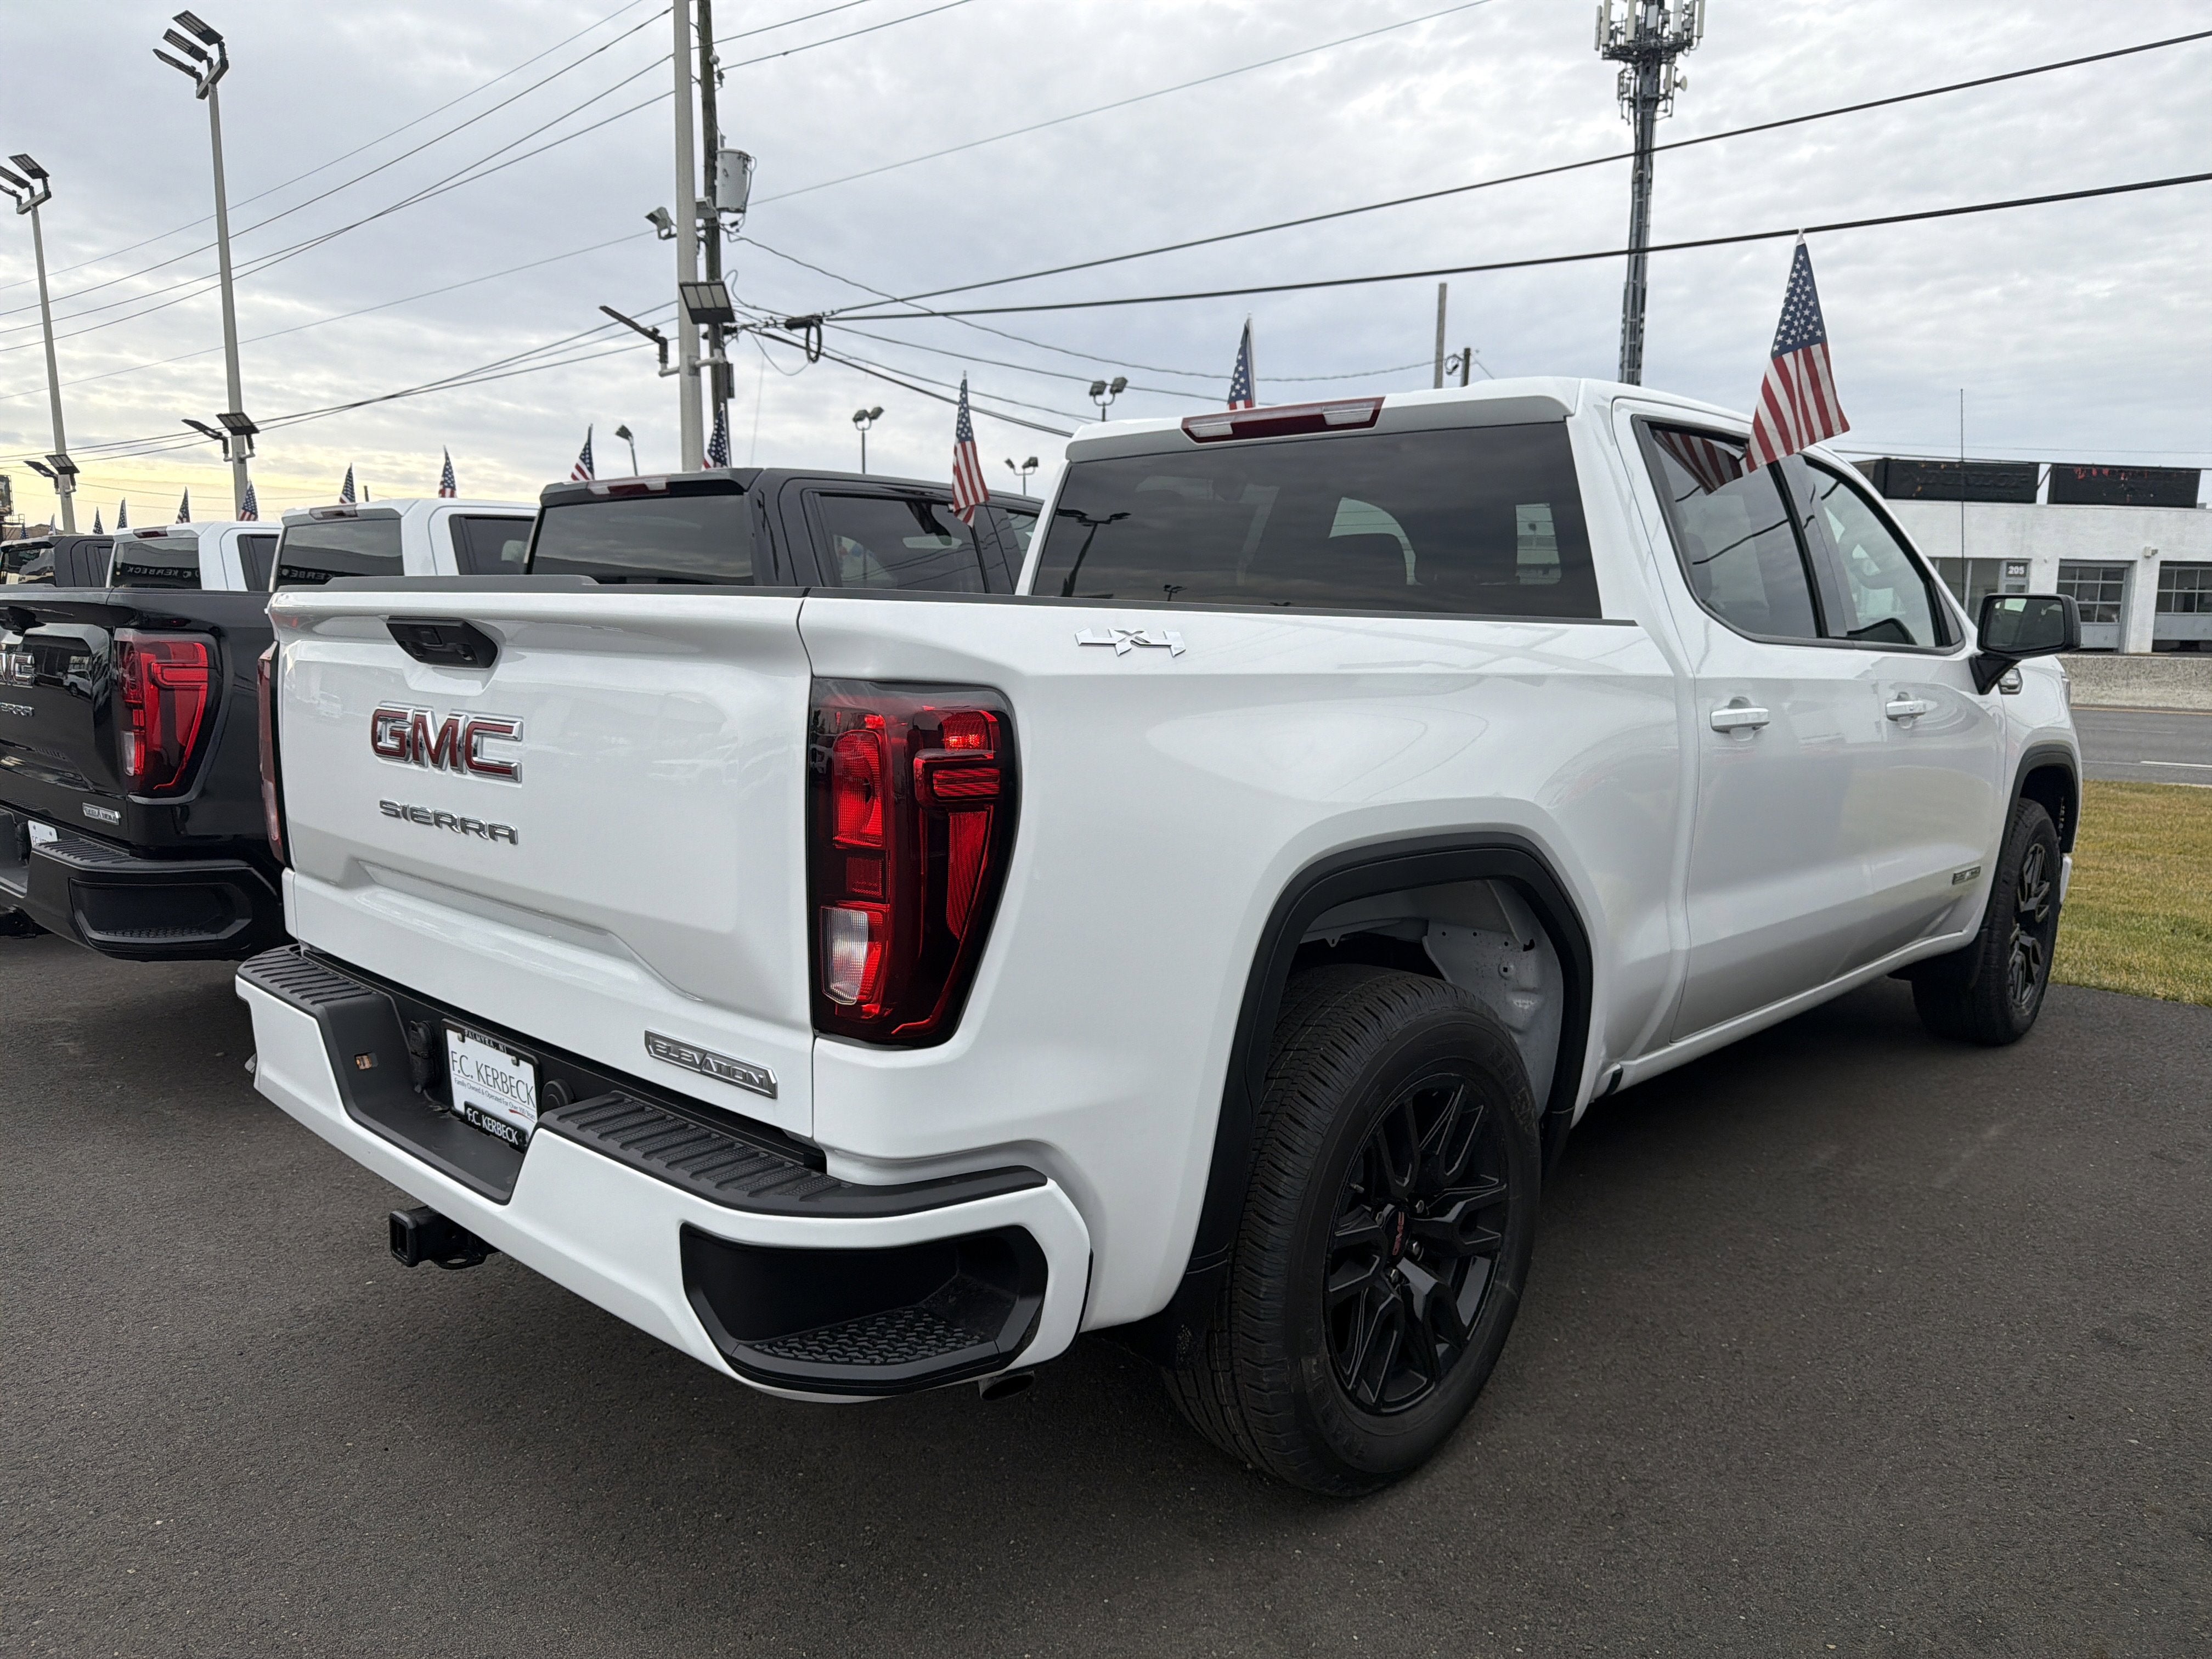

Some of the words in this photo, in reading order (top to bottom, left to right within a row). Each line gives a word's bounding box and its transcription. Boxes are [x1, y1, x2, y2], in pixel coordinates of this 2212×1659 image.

[2008, 565, 2024, 575] 205
[0, 652, 35, 686] MC
[0, 702, 35, 716] ERRA
[371, 705, 524, 783] GMC
[379, 798, 518, 845] SIERRA
[464, 1029, 497, 1049] PALMYRA,
[450, 1050, 474, 1079] F.C.
[476, 1060, 535, 1108] KERBECK
[653, 1039, 764, 1087] ELEVATION
[467, 1107, 481, 1126] F.C.
[482, 1114, 518, 1146] KERBECK
